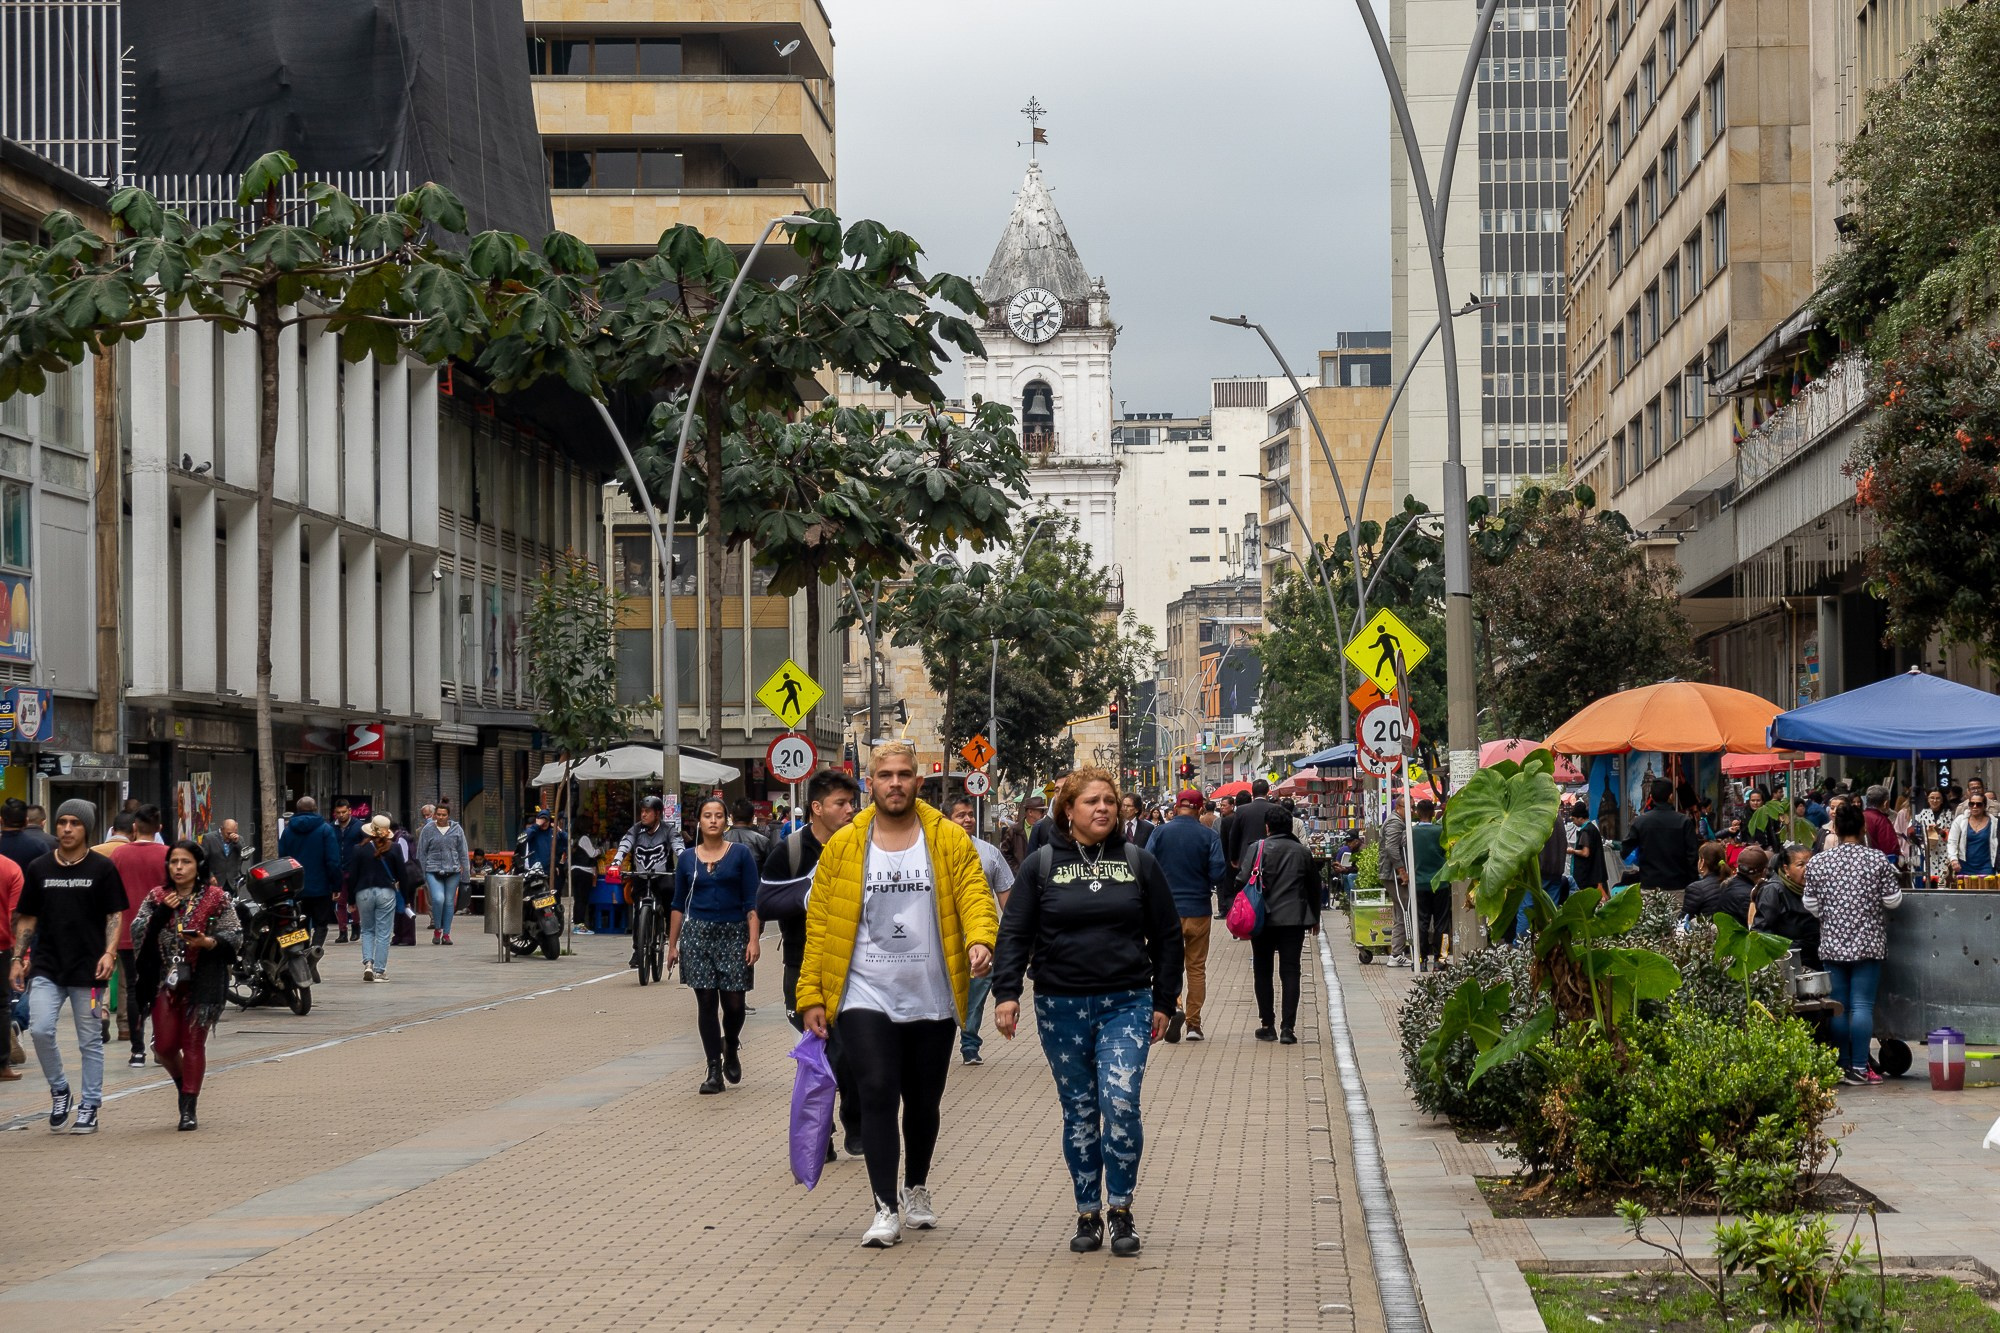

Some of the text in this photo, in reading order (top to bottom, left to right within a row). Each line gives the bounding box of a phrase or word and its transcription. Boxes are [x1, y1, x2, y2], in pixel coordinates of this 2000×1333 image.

[1373, 720, 1401, 742] 20
[780, 749, 804, 767] 20
[69, 878, 93, 888] WORLD
[872, 882, 924, 894] FUTURE
